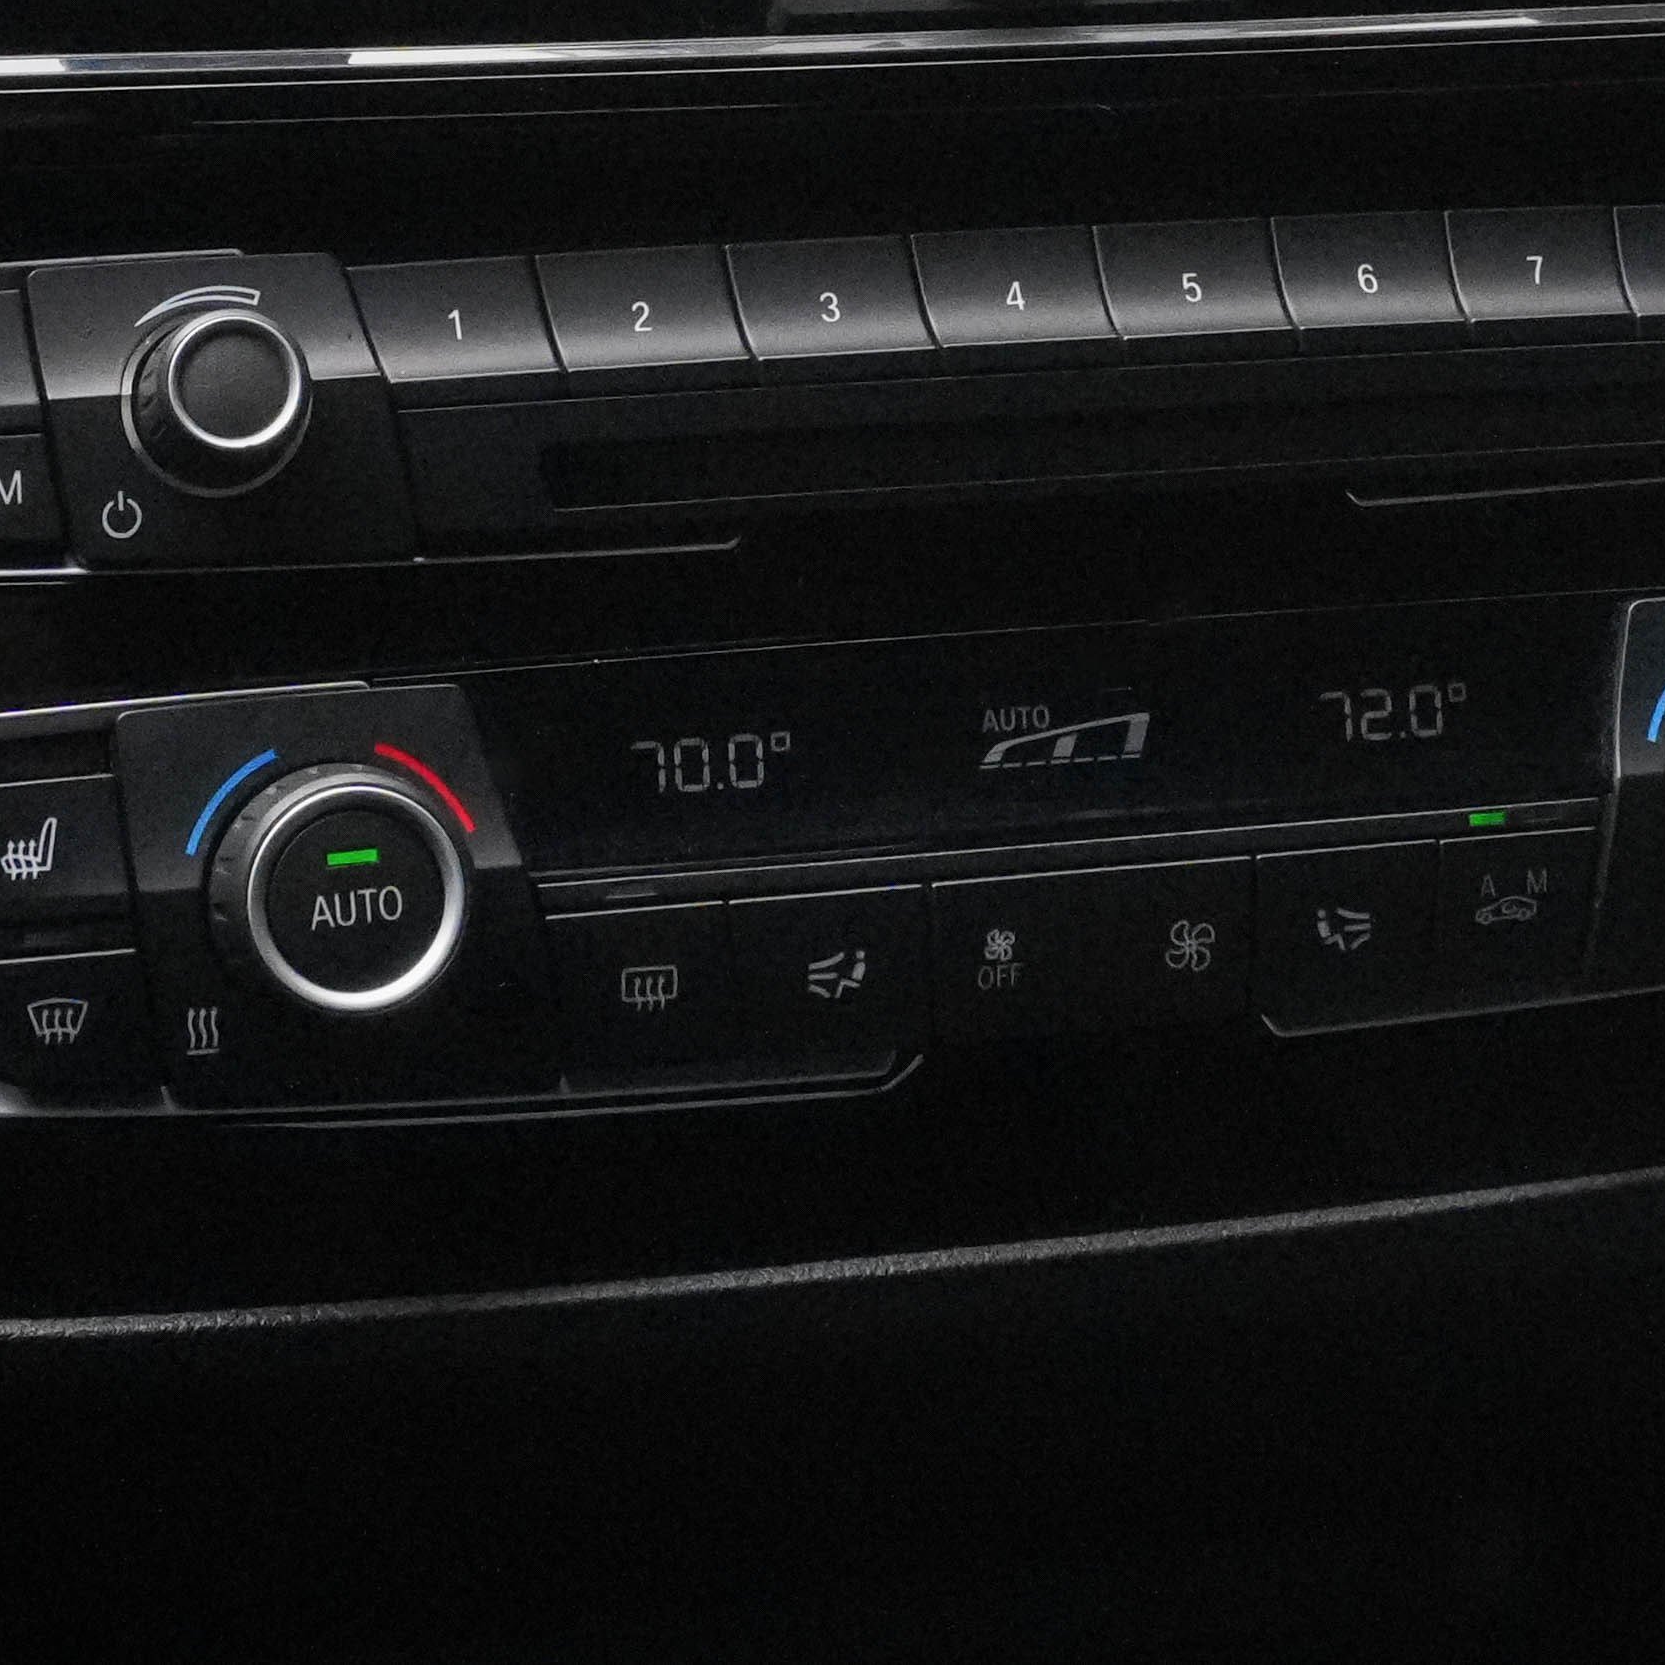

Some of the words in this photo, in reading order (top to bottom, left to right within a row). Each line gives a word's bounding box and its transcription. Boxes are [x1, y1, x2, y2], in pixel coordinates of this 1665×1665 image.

[1358, 265, 1378, 293] 6
[1527, 256, 1542, 284] 7
[1006, 282, 1025, 311] 4
[1183, 273, 1202, 302] 5
[632, 302, 652, 332] 2
[820, 293, 840, 322] 3
[449, 310, 462, 340] 1
[982, 704, 1051, 733] AUTO
[1481, 874, 1496, 897] A
[1525, 867, 1549, 896] M
[312, 886, 402, 930] AUTO
[977, 964, 1021, 990] OFF
